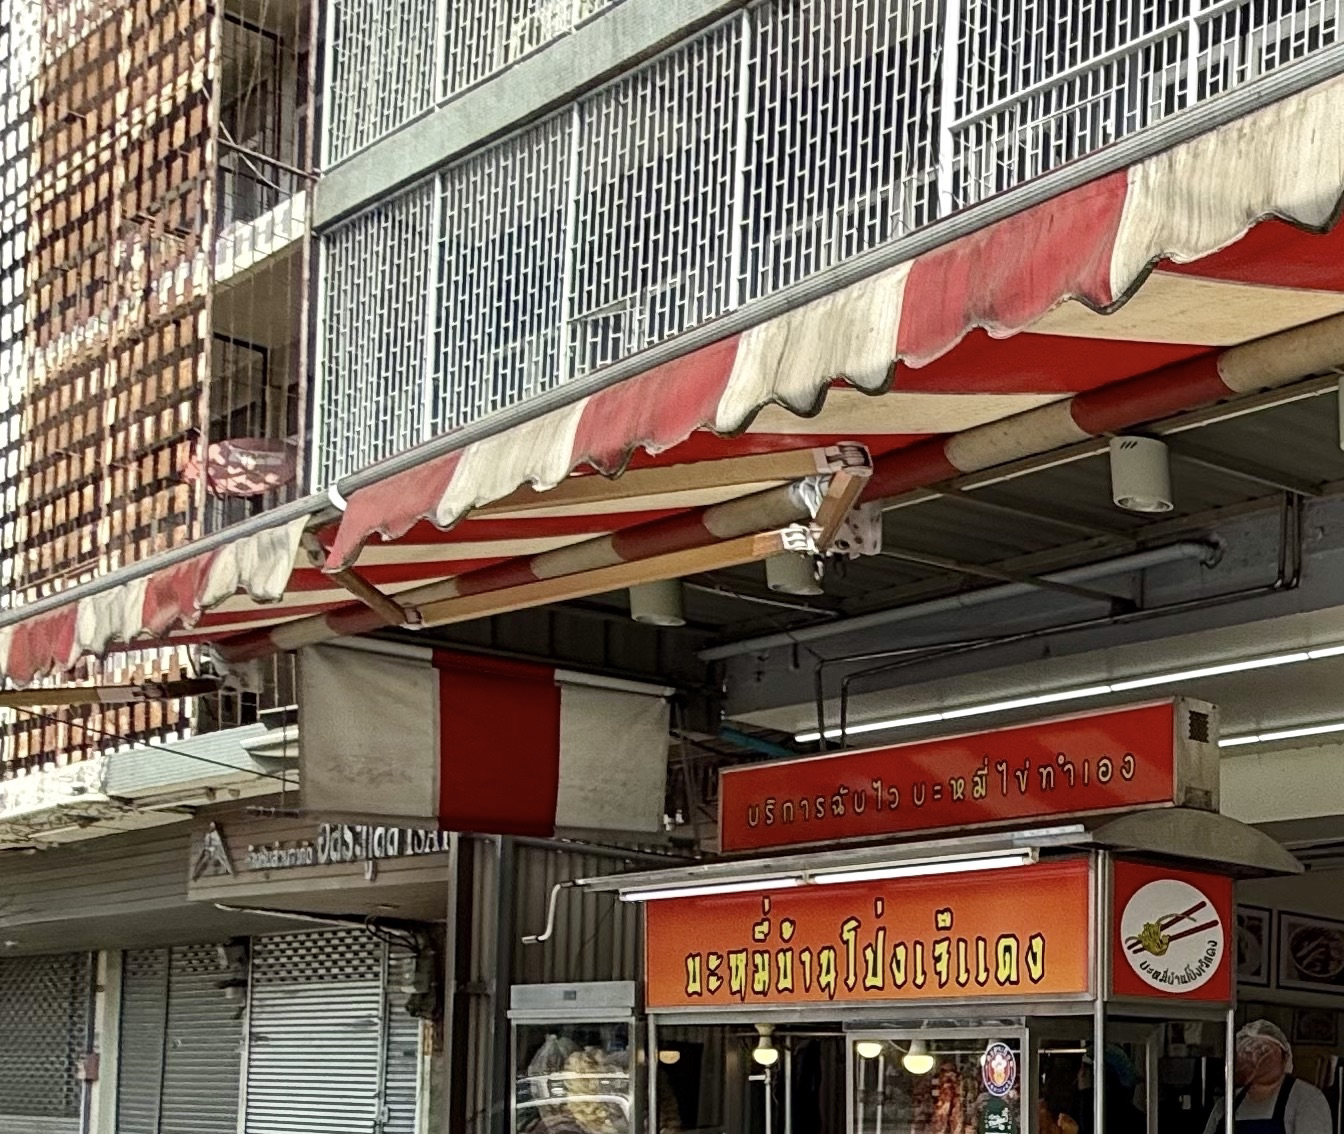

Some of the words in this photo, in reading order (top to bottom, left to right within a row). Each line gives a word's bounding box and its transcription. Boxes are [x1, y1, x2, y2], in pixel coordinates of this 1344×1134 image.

[746, 778, 901, 828] บริการฉับไว
[911, 752, 1138, 808] บะหมี่ไข่ทำเอง
[684, 896, 1046, 1003] บะหมี่บ้านโป่งเจ๊แดง
